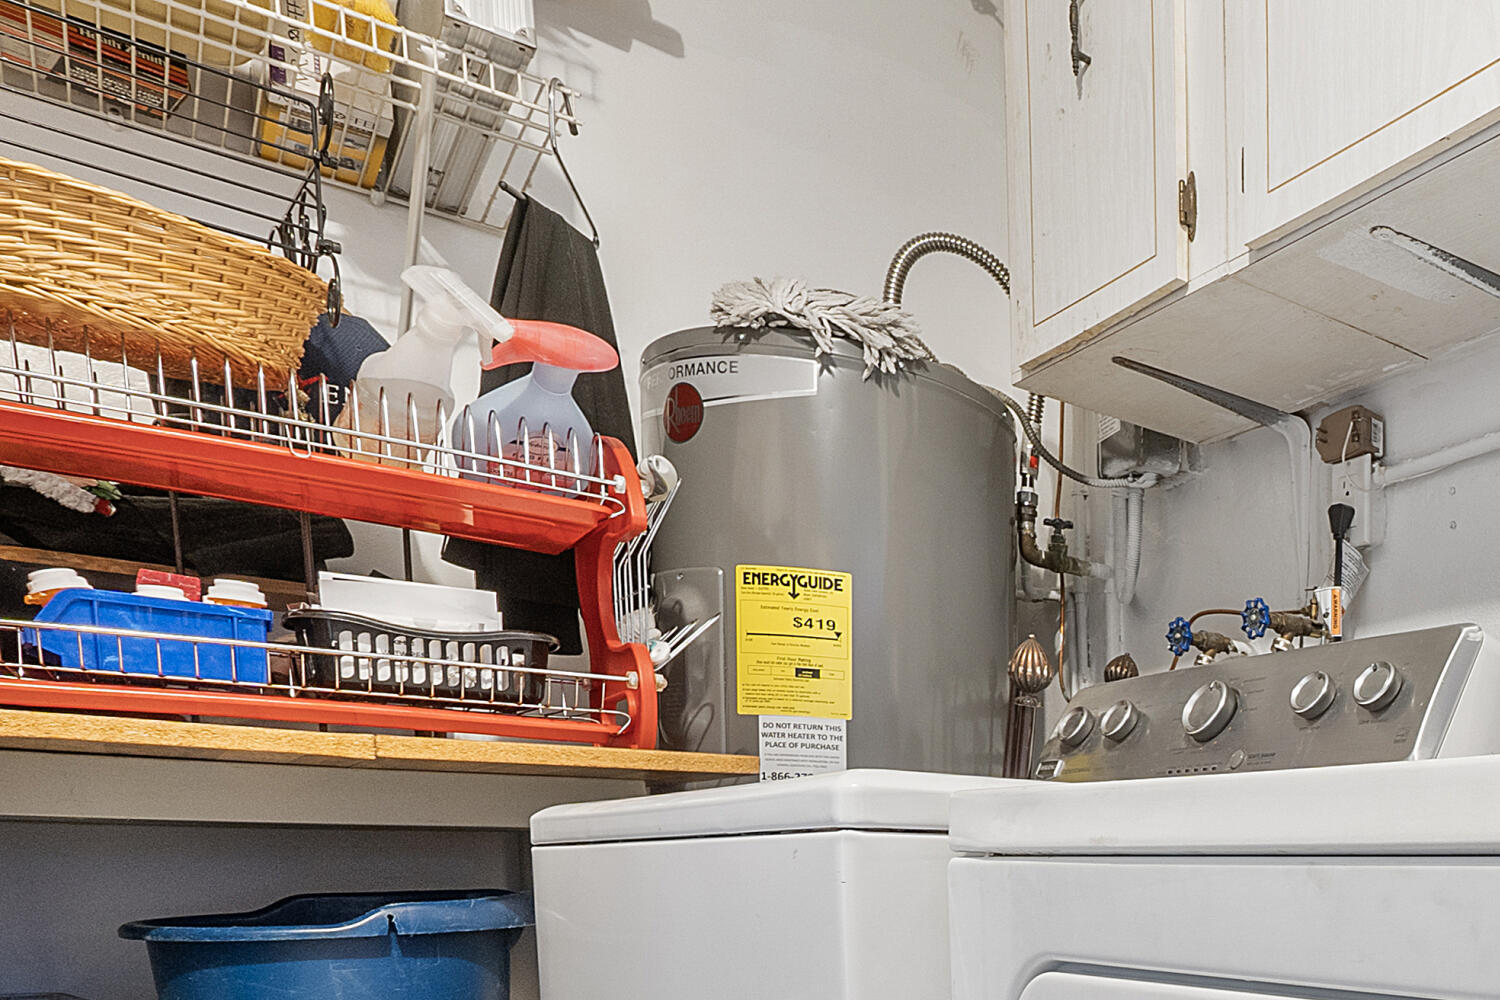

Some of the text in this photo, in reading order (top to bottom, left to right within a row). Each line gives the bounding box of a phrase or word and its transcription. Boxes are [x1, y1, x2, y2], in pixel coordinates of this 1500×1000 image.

[646, 361, 739, 389] PEORMANCE
[743, 571, 843, 598] ENERGYGUIDE
[793, 723, 823, 731] RETURN
[800, 742, 840, 751] PURCHASE
